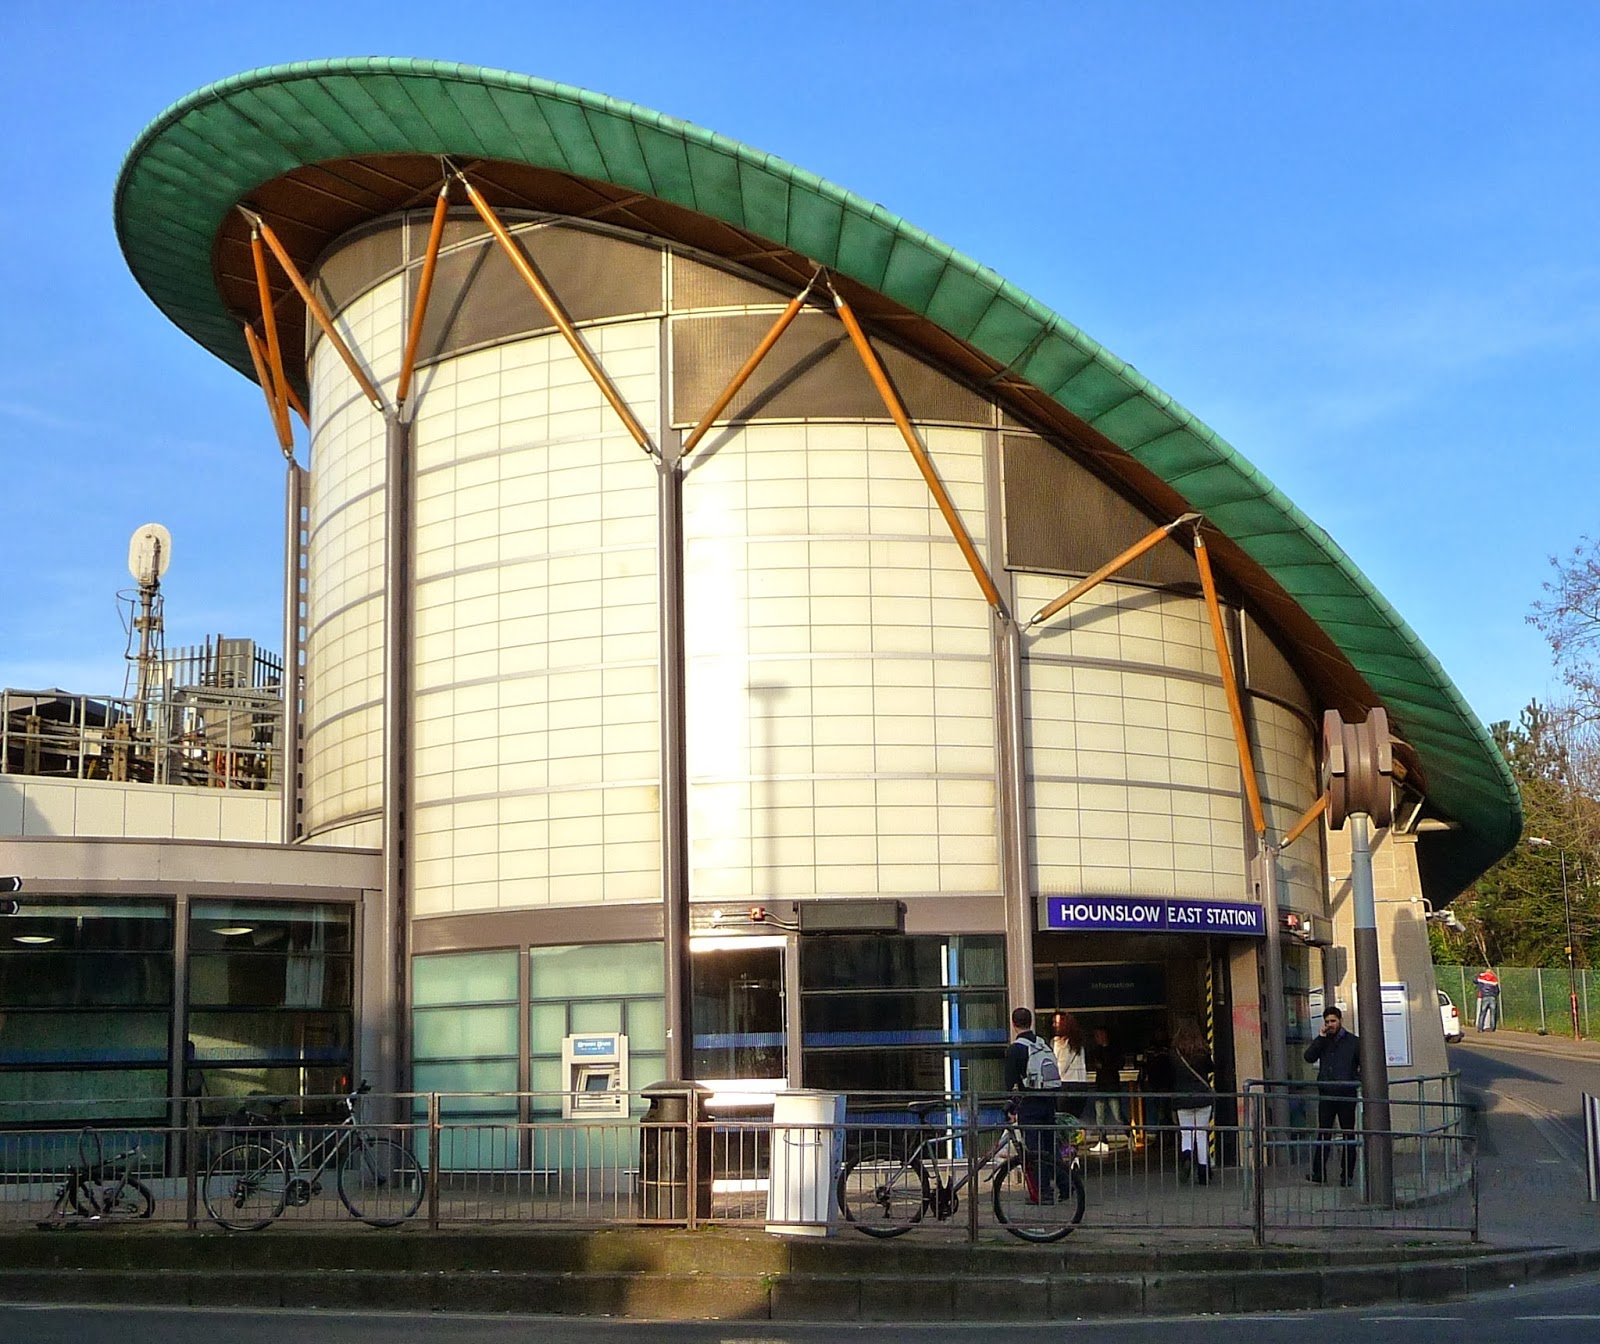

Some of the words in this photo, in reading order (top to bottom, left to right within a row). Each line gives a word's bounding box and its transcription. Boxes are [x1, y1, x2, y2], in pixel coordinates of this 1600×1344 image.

[1061, 904, 1160, 922] HOUNSLOW
[1168, 906, 1203, 923] EAST
[1206, 908, 1257, 926] STATION
